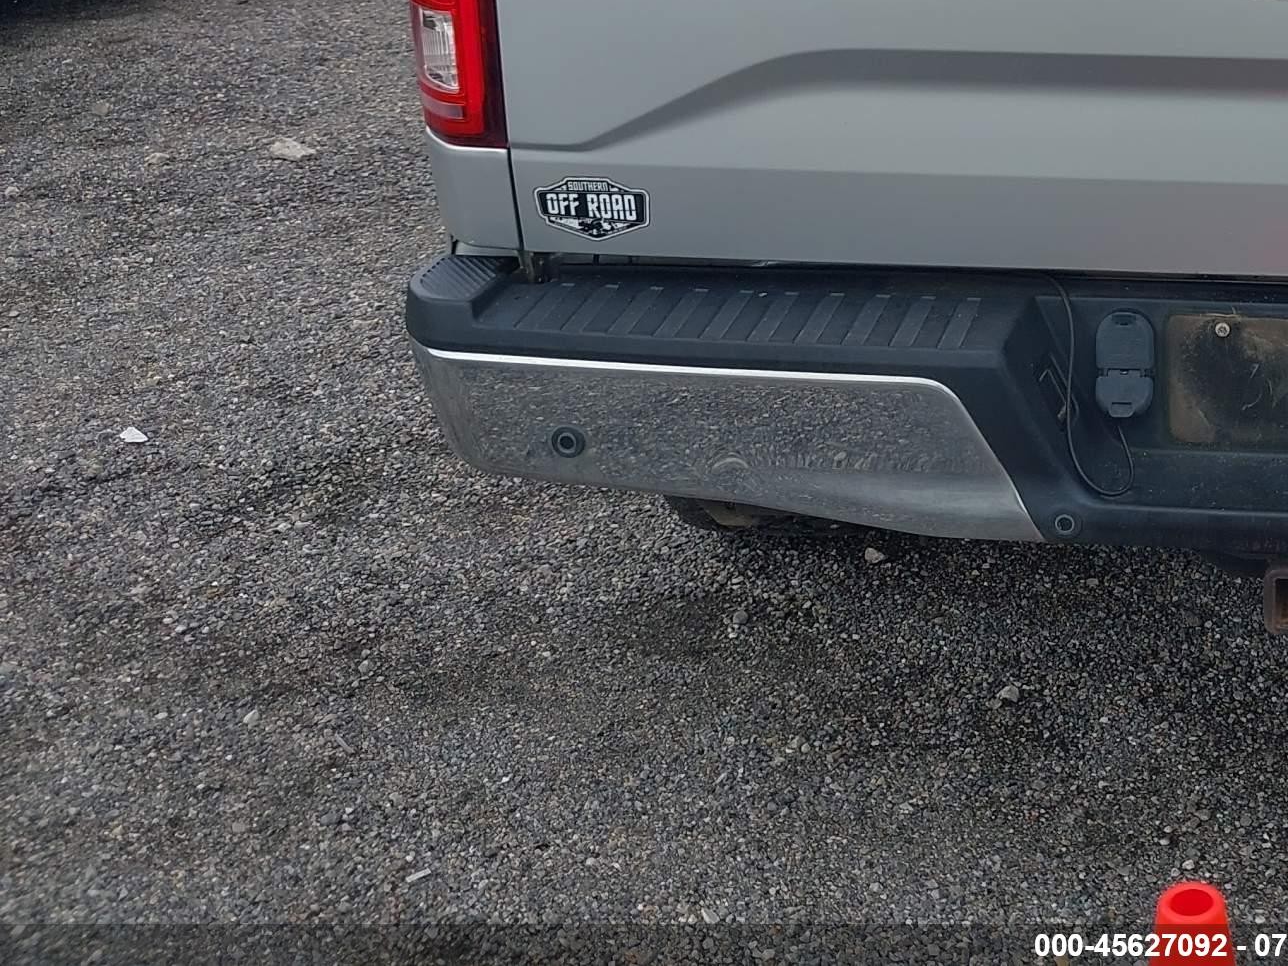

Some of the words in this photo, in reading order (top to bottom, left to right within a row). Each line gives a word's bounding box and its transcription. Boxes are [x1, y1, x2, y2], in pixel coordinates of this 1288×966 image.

[567, 181, 609, 192] SOUTHERN
[546, 193, 580, 216] OFF
[586, 193, 638, 221] ROAD
